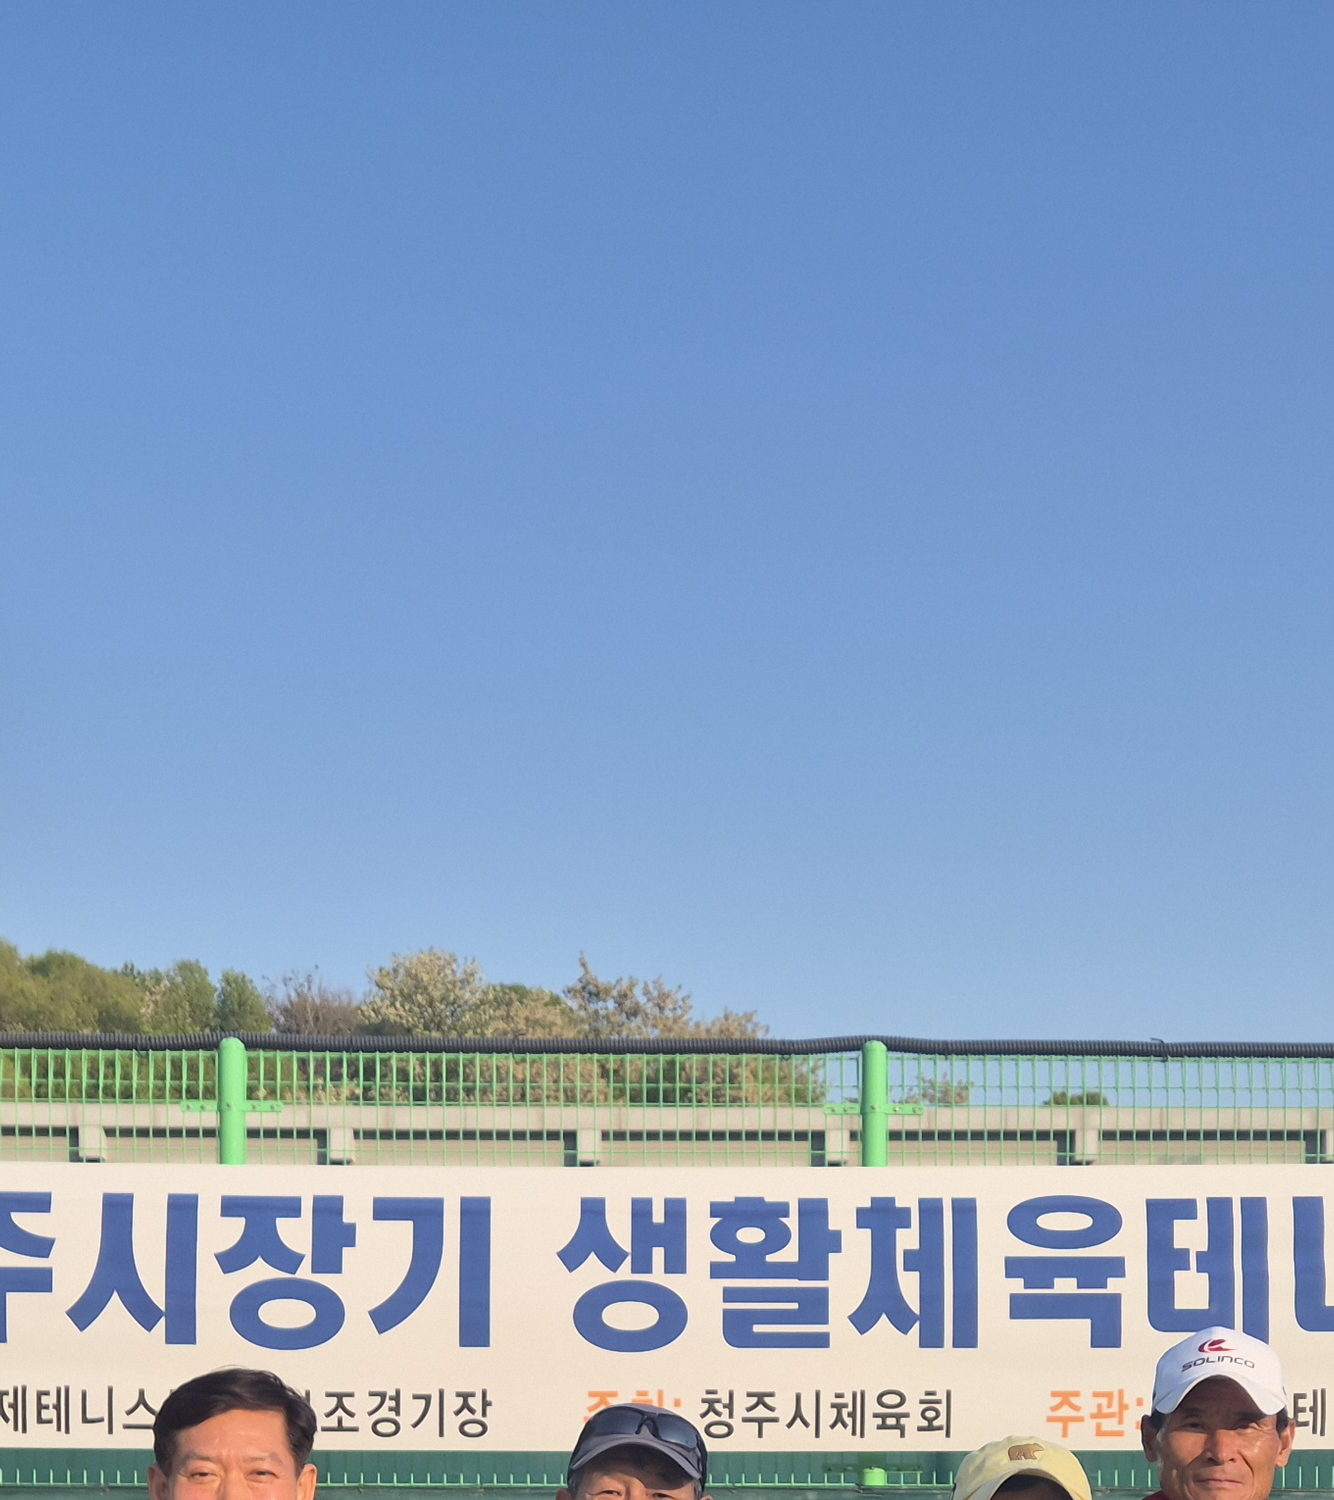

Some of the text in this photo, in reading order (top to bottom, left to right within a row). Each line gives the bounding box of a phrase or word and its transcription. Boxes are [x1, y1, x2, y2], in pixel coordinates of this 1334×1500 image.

[1181, 1355, 1256, 1373] SOLINCO
[305, 1387, 493, 1438] 조경기장
[698, 1387, 953, 1439] 청주시체육회
[1045, 1388, 1145, 1439] 주관:
